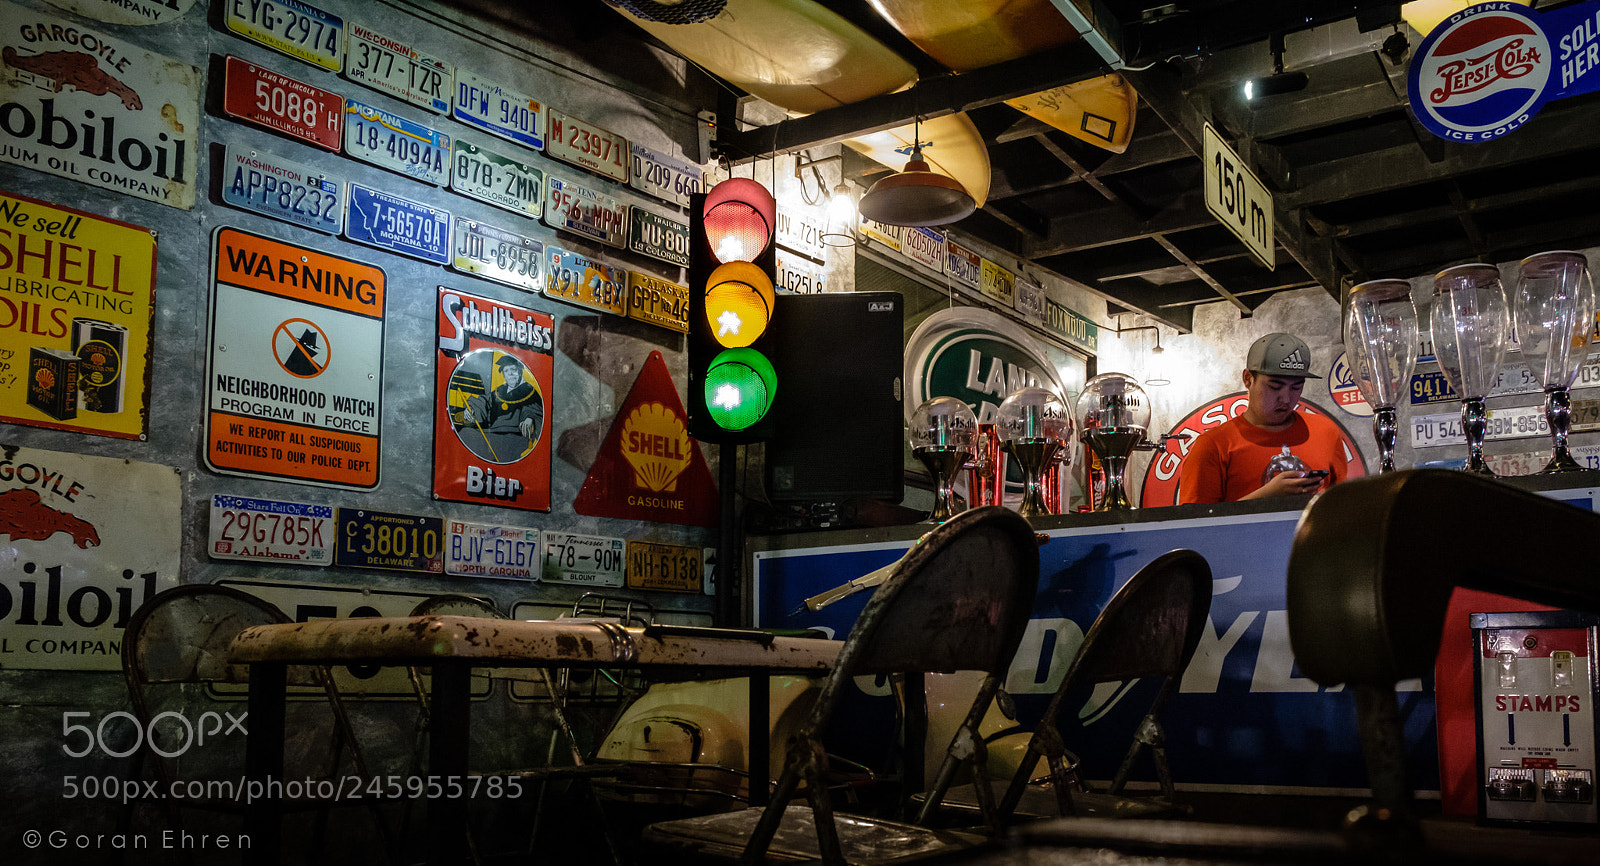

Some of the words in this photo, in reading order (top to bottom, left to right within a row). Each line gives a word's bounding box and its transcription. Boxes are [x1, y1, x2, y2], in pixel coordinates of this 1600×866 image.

[1450, 3, 1512, 24] DRINK
[20, 23, 131, 74] GARGOYLE
[354, 26, 409, 55] WISCONSIN
[258, 70, 277, 82] LAND
[278, 77, 288, 86] OF
[288, 81, 315, 96] LINCOLN
[351, 67, 365, 80] APR
[358, 42, 442, 99] 377-TZR
[255, 79, 317, 128] 5088
[353, 102, 402, 129] MONTANA
[459, 82, 489, 116] DFW
[500, 99, 538, 136] 9401
[1445, 129, 1474, 140] ICE
[1481, 113, 1530, 139] COLD
[552, 117, 563, 144] M
[570, 125, 622, 167] 23971
[236, 154, 301, 182] WASHINGTON
[578, 156, 599, 169] OHIO
[634, 155, 642, 178] D
[646, 161, 671, 189] 209
[48, 157, 79, 176] OIL
[88, 168, 171, 200] COMPANY
[232, 166, 337, 224] APP8232
[376, 194, 408, 208] TREASURE
[409, 203, 428, 214] STATE
[476, 187, 520, 207] COLORADO
[552, 190, 582, 220] 956
[1216, 151, 1246, 227] 150
[1251, 198, 1267, 249] m
[33, 215, 82, 239] sell
[256, 204, 291, 219] EVERGREEN
[293, 215, 312, 225] STATE
[380, 230, 422, 249] MONTANA
[0, 228, 134, 296] SHELL
[575, 257, 601, 272] UTAH
[646, 246, 687, 264] COLORADO
[226, 245, 376, 306] WARNING
[648, 279, 686, 299] ALASKA
[632, 285, 660, 313] GPP
[439, 294, 553, 352] Schultheiss
[1047, 302, 1086, 341] FOXWOOD
[1088, 335, 1095, 348] DR
[966, 348, 1043, 398] LAND
[1280, 362, 1305, 370] adidas
[217, 374, 326, 409] NEIGHBORHOOD
[333, 395, 375, 418] WATCH
[221, 397, 294, 420] PROGRAM
[303, 412, 316, 424] IN
[325, 415, 370, 433] FORCE
[229, 423, 244, 436] WE
[248, 426, 286, 442] REPORT
[289, 433, 306, 446] ALL
[309, 435, 361, 454] SUSPICIOUS
[628, 431, 684, 461] SHELL
[1416, 424, 1433, 440] PU
[216, 440, 268, 458] ACTIVITIES
[271, 447, 283, 460] TO
[287, 450, 306, 464] OUR
[312, 454, 342, 469] POLICE
[348, 459, 371, 473] DEPT.
[466, 465, 521, 499] Bier
[247, 500, 269, 511] Stars
[270, 503, 286, 513] Fell
[287, 504, 300, 515] On
[627, 495, 685, 511] GASOLINE
[221, 510, 324, 548] 29G785K
[370, 515, 415, 525] APPORTIONED
[501, 530, 520, 538] Flight
[239, 546, 301, 560] Alabama
[361, 523, 437, 559] 38010
[452, 535, 536, 567] BJV-6167
[565, 535, 605, 547] Tennessee
[367, 556, 415, 568] DELAWARE
[455, 564, 486, 574] NORTH
[489, 566, 530, 577] CAROLINA
[546, 543, 621, 572] F78-90M
[634, 552, 698, 580] NH-6138
[570, 573, 596, 581] BLOUNT
[26, 639, 120, 655] COMPAN
[1496, 695, 1580, 713] STAMPS
